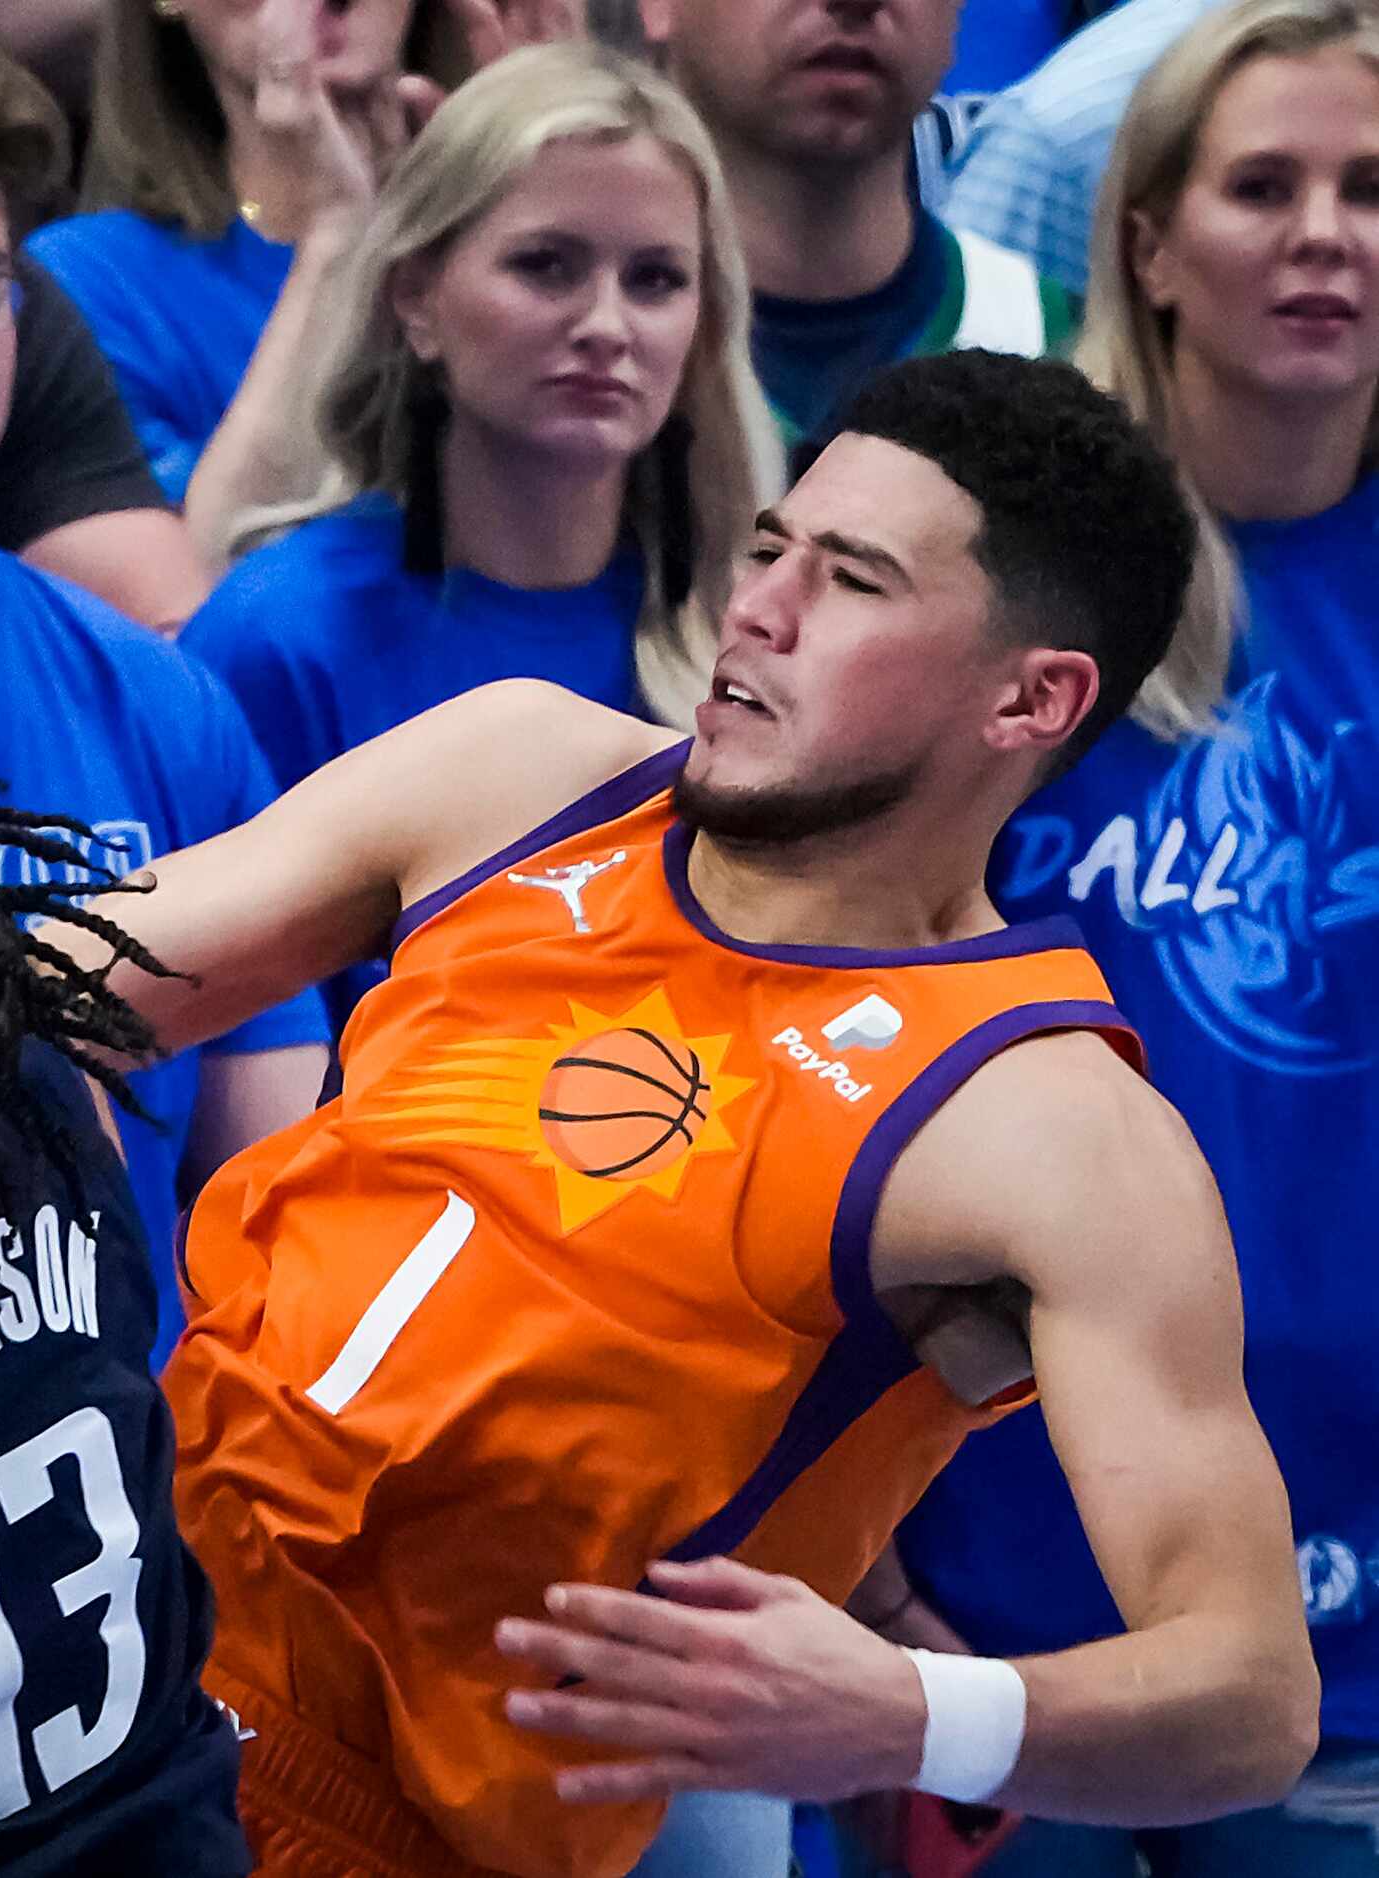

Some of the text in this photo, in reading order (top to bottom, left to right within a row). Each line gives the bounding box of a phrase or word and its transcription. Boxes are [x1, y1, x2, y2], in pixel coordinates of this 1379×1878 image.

[997, 814, 1379, 946] DALLAS
[771, 1026, 872, 1102] PayPal
[305, 1188, 475, 1415] 1
